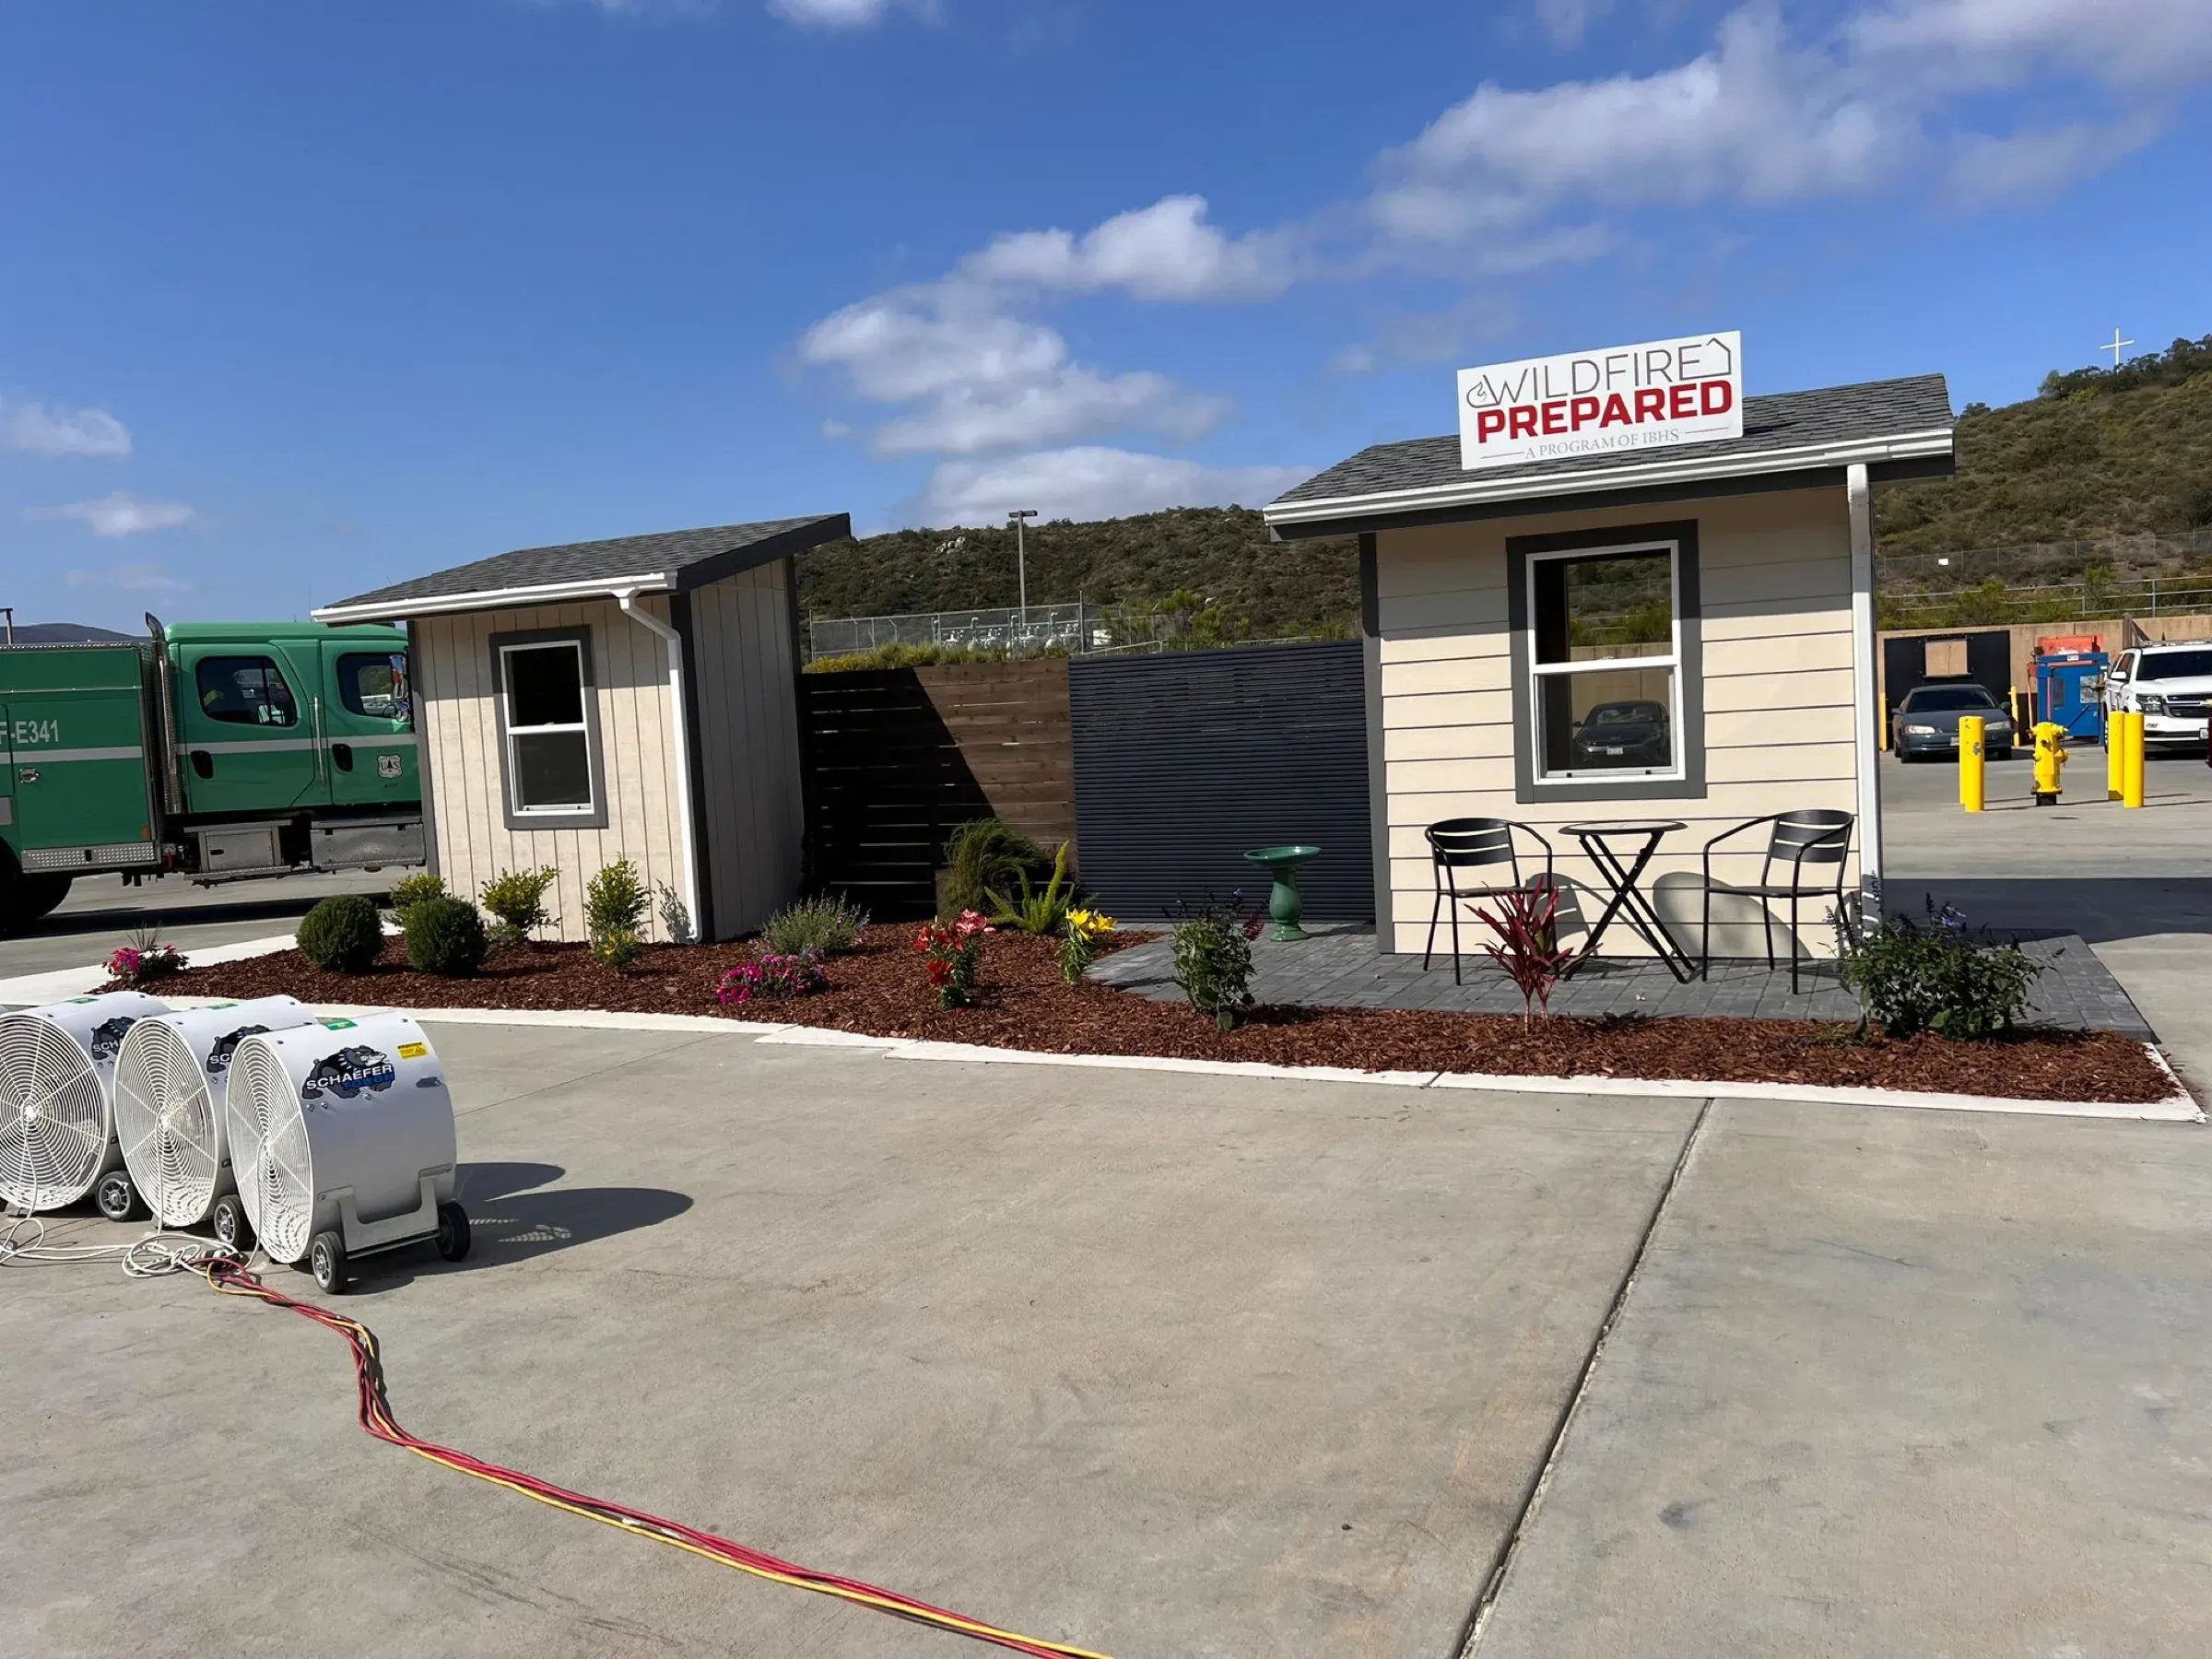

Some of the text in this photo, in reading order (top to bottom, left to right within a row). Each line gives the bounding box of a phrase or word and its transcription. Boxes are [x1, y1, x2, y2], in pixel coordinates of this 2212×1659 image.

[1482, 344, 1702, 404] WILDFIRE
[1477, 380, 1733, 444] PREPARED
[1525, 428, 1679, 460] A PROGRAM OF IBHS
[306, 1064, 393, 1090] SCHAEFER
